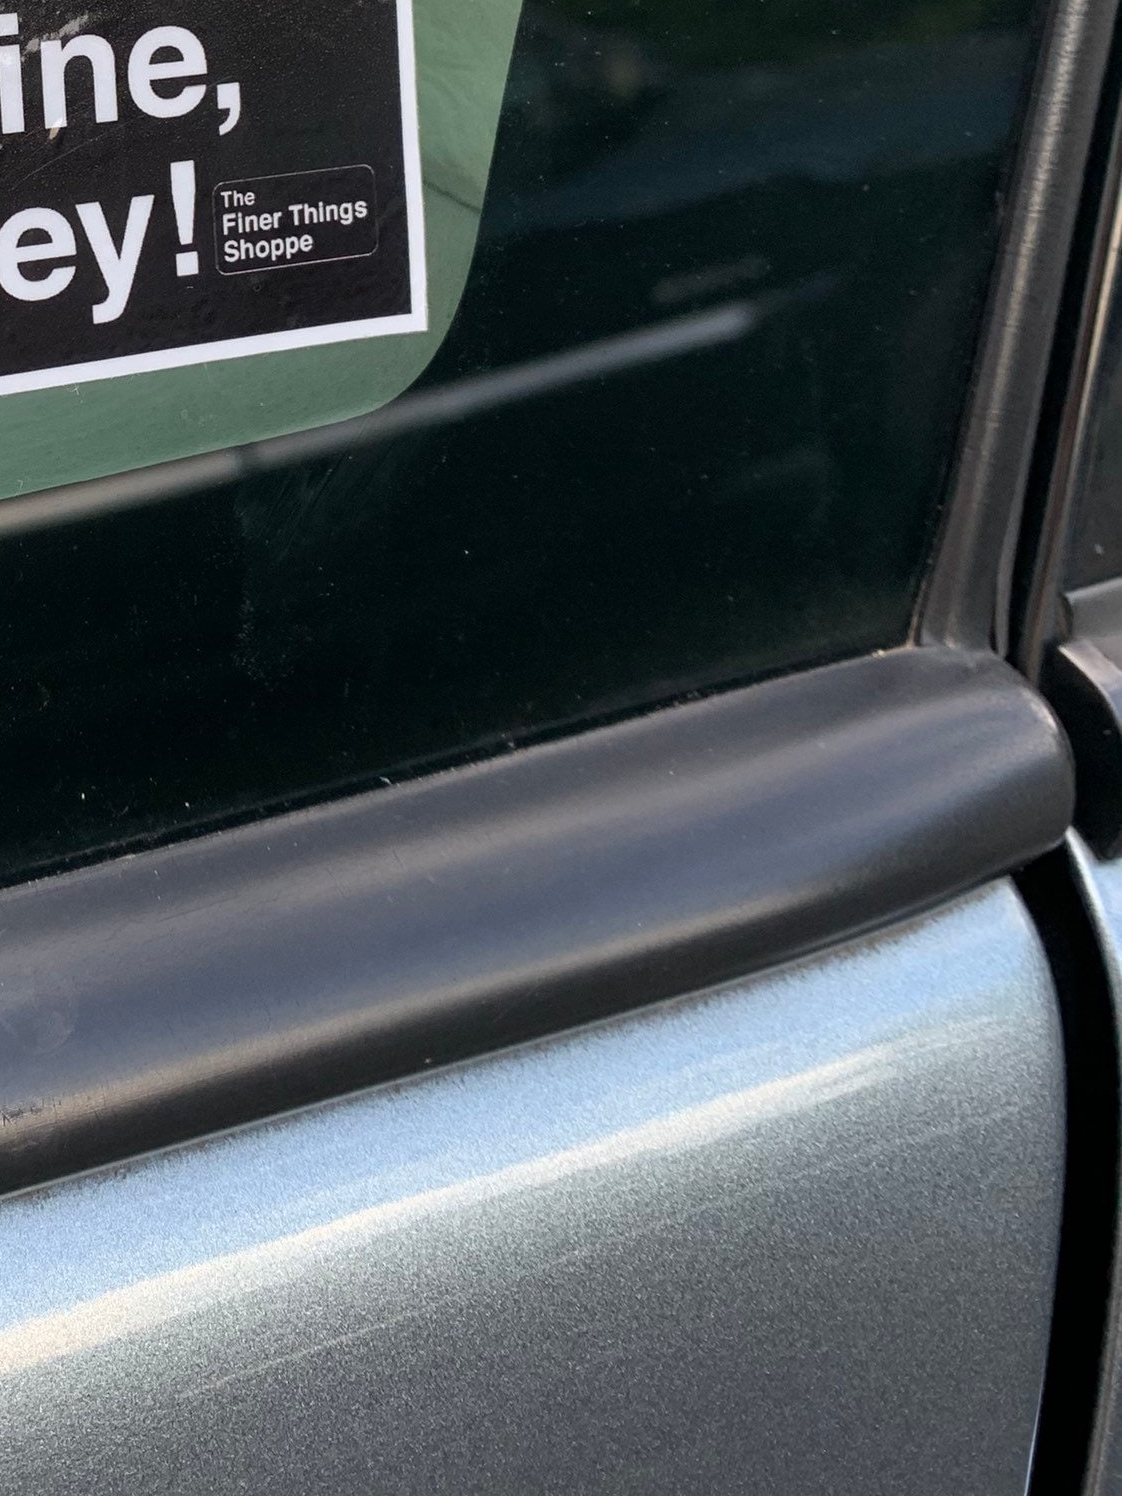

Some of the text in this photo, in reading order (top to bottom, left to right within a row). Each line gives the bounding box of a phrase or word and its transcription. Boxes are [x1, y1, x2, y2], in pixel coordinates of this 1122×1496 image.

[220, 189, 256, 208] The
[222, 200, 368, 236] Finer Things
[223, 233, 314, 263] Shoppe
